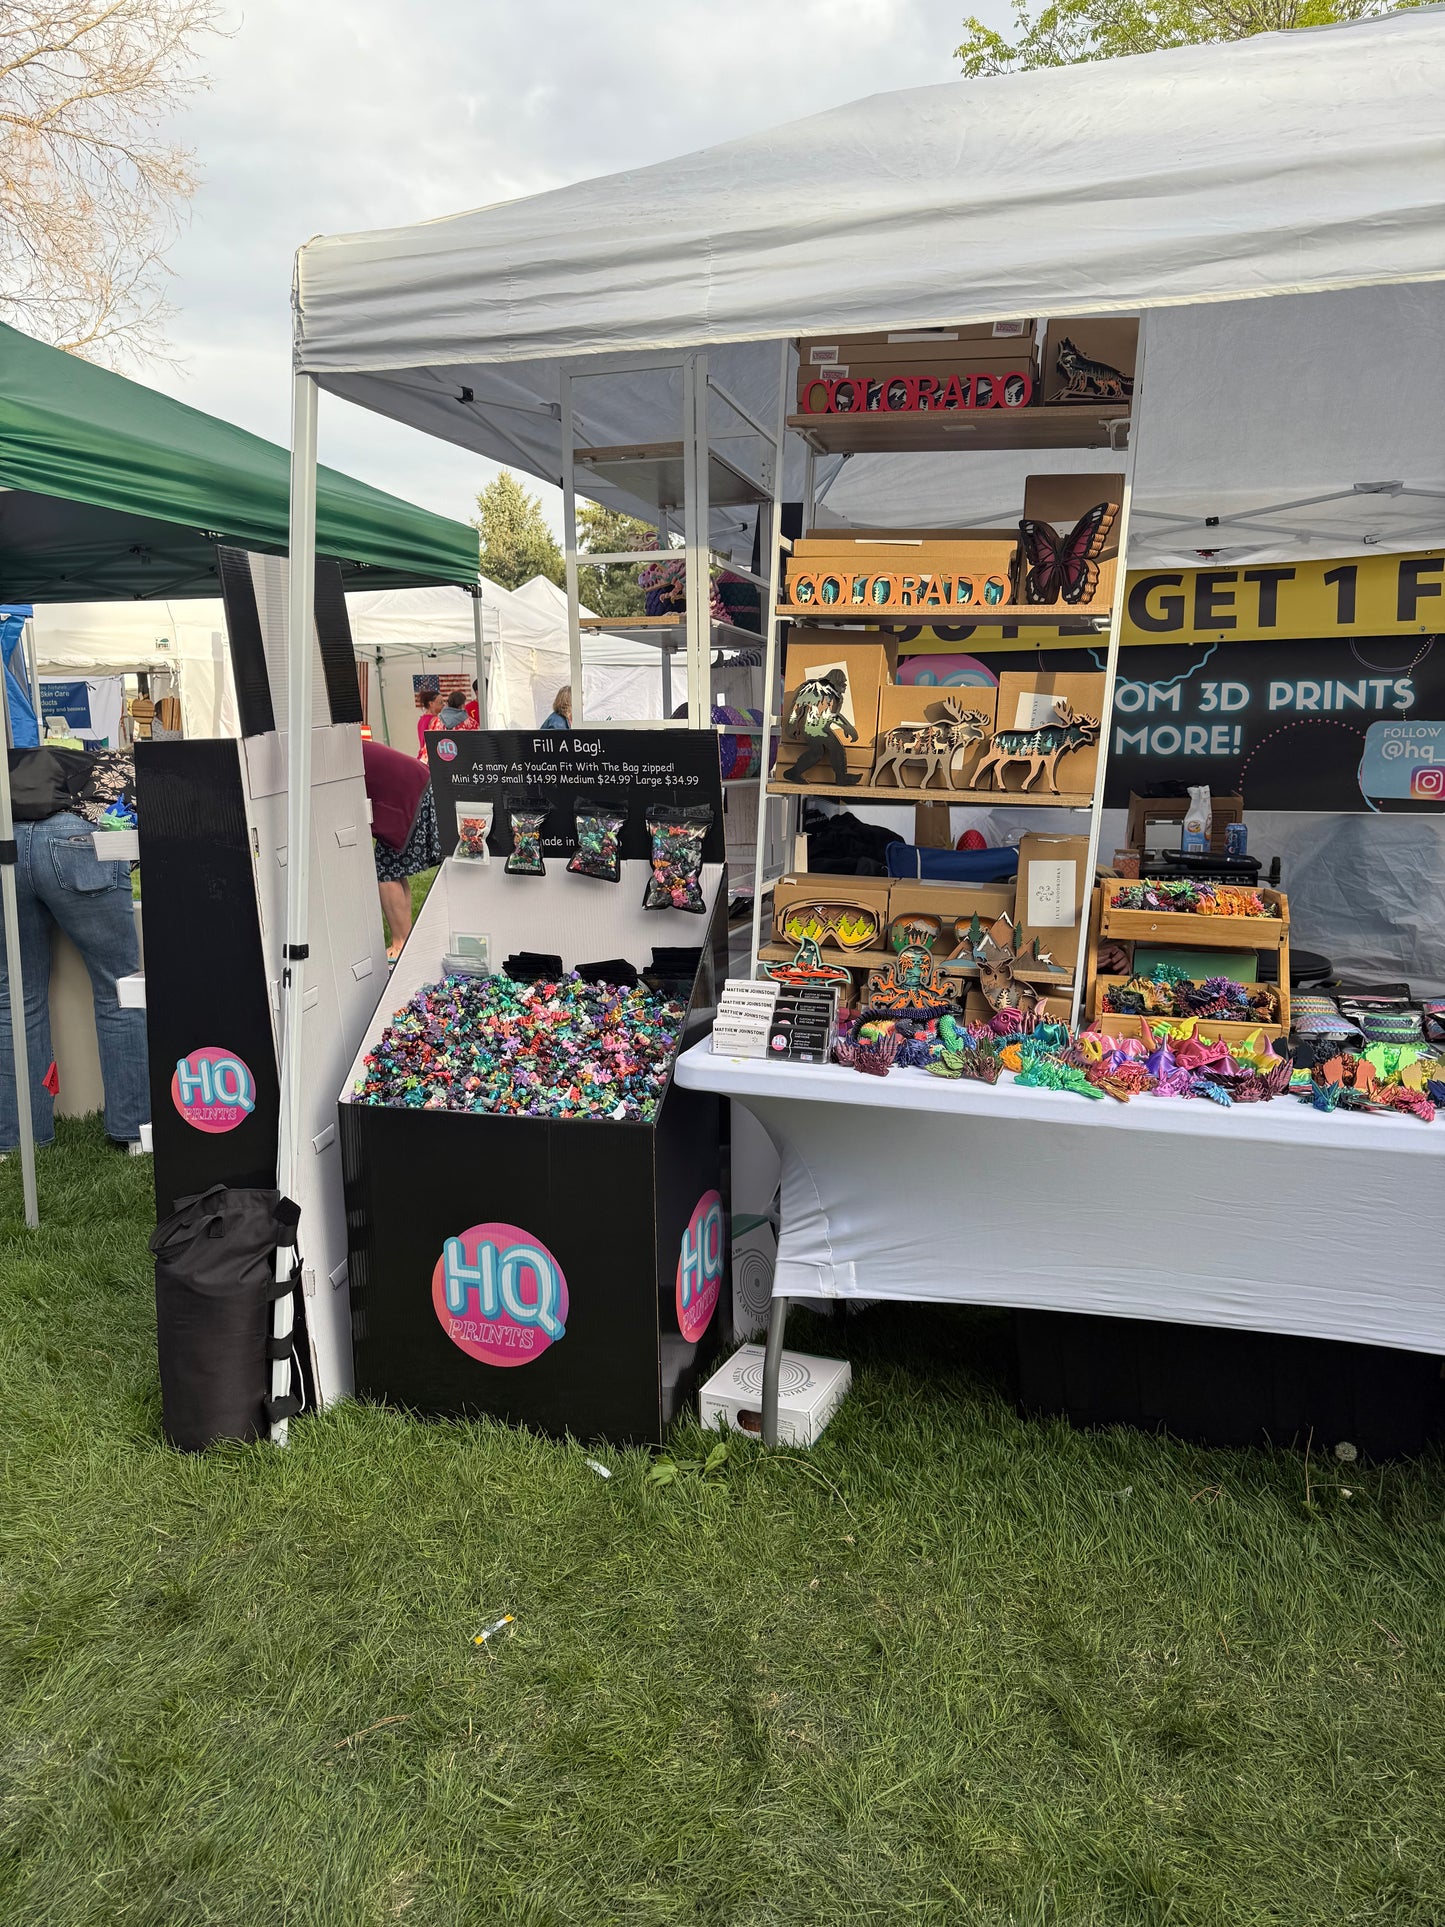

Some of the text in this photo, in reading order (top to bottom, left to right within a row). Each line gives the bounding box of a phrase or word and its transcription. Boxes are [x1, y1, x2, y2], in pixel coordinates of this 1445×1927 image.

[801, 370, 1033, 415] COLORADO
[789, 571, 1012, 606] COLORADO
[1128, 558, 1445, 633] GET 1 F
[1198, 682, 1250, 712] 3D
[1269, 678, 1415, 710] PRINTS
[532, 739, 554, 753] Fill
[559, 740, 569, 752] A
[1115, 725, 1243, 756] MORE!
[1383, 727, 1442, 738] FOLLOW
[436, 741, 458, 756] HQ
[451, 774, 470, 783] Mini
[472, 774, 499, 785] $9.99
[501, 774, 524, 784] small
[526, 774, 557, 785] $14.99
[560, 774, 595, 784] Medium
[635, 775, 662, 787] Large
[664, 775, 699, 787] $34.99
[472, 762, 675, 776] As many As YouCan Fit With The Bag zipped!
[565, 836, 575, 847] in
[743, 1012, 770, 1020] JOHNSTONE
[772, 1036, 788, 1048] HQ
[177, 1058, 255, 1112] HQ
[183, 1107, 237, 1120] PRINTS
[681, 1200, 724, 1309] HQ
[443, 1236, 566, 1341] HQ
[682, 1281, 717, 1335] PRINTS
[448, 1318, 534, 1350] PRINTS
